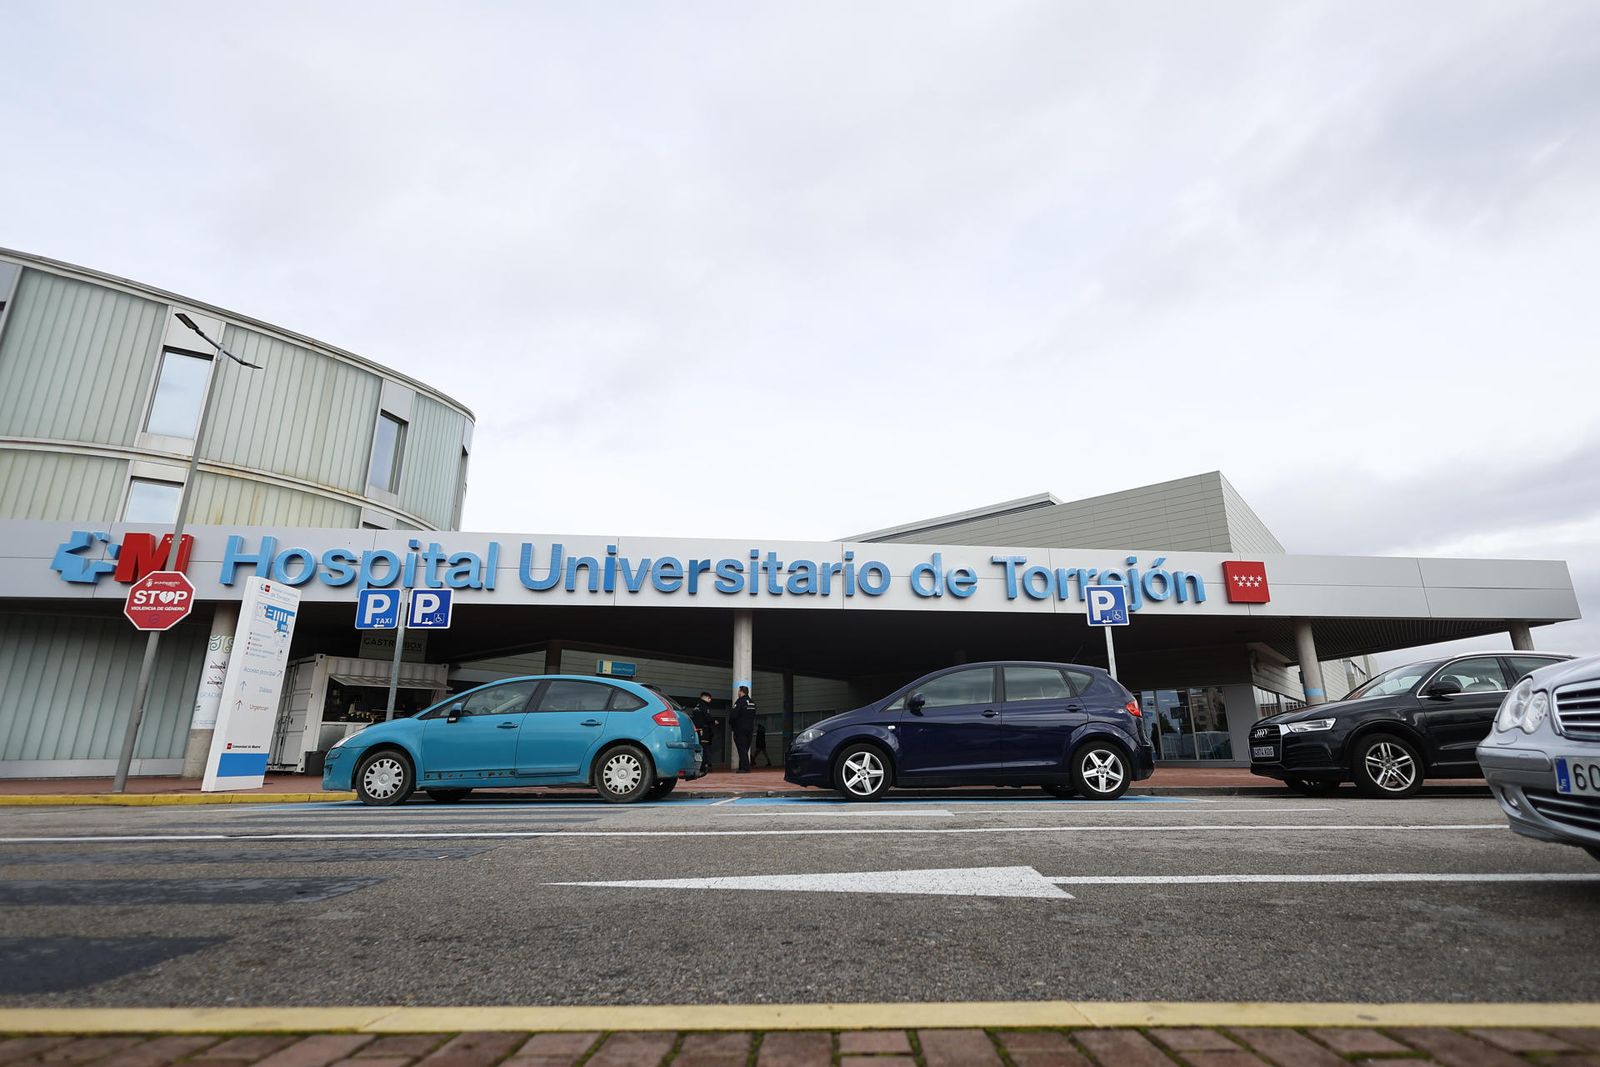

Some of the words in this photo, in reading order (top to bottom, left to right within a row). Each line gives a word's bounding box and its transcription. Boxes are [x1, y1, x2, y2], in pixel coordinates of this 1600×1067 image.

[218, 535, 501, 598] Hospital
[518, 542, 892, 597] Universitario
[910, 552, 979, 599] de
[990, 553, 1207, 612] Torrejón
[363, 593, 391, 624] P
[413, 593, 440, 624] P
[1090, 590, 1115, 621] P
